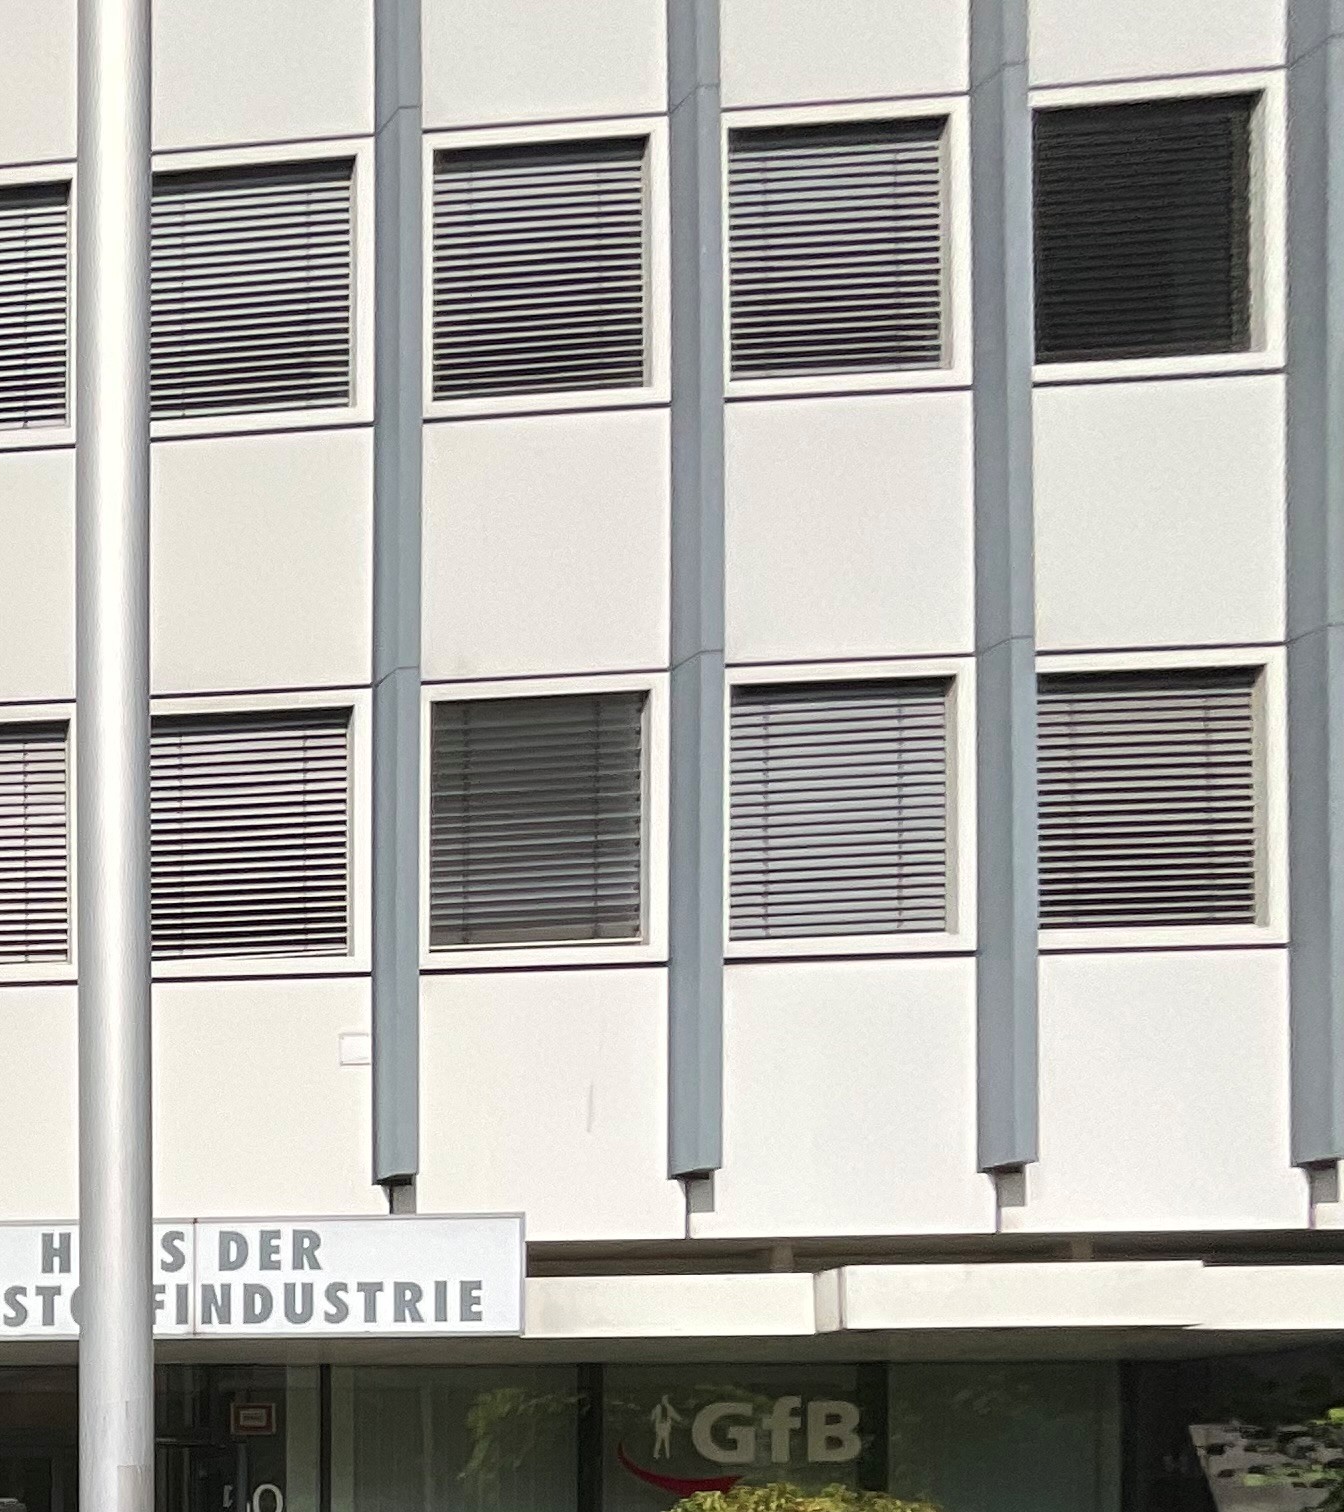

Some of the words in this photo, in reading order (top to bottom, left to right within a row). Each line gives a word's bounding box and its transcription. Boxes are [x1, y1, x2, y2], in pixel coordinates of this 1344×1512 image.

[41, 1230, 186, 1274] HS
[218, 1229, 323, 1272] DER
[691, 1395, 862, 1464] GfB
